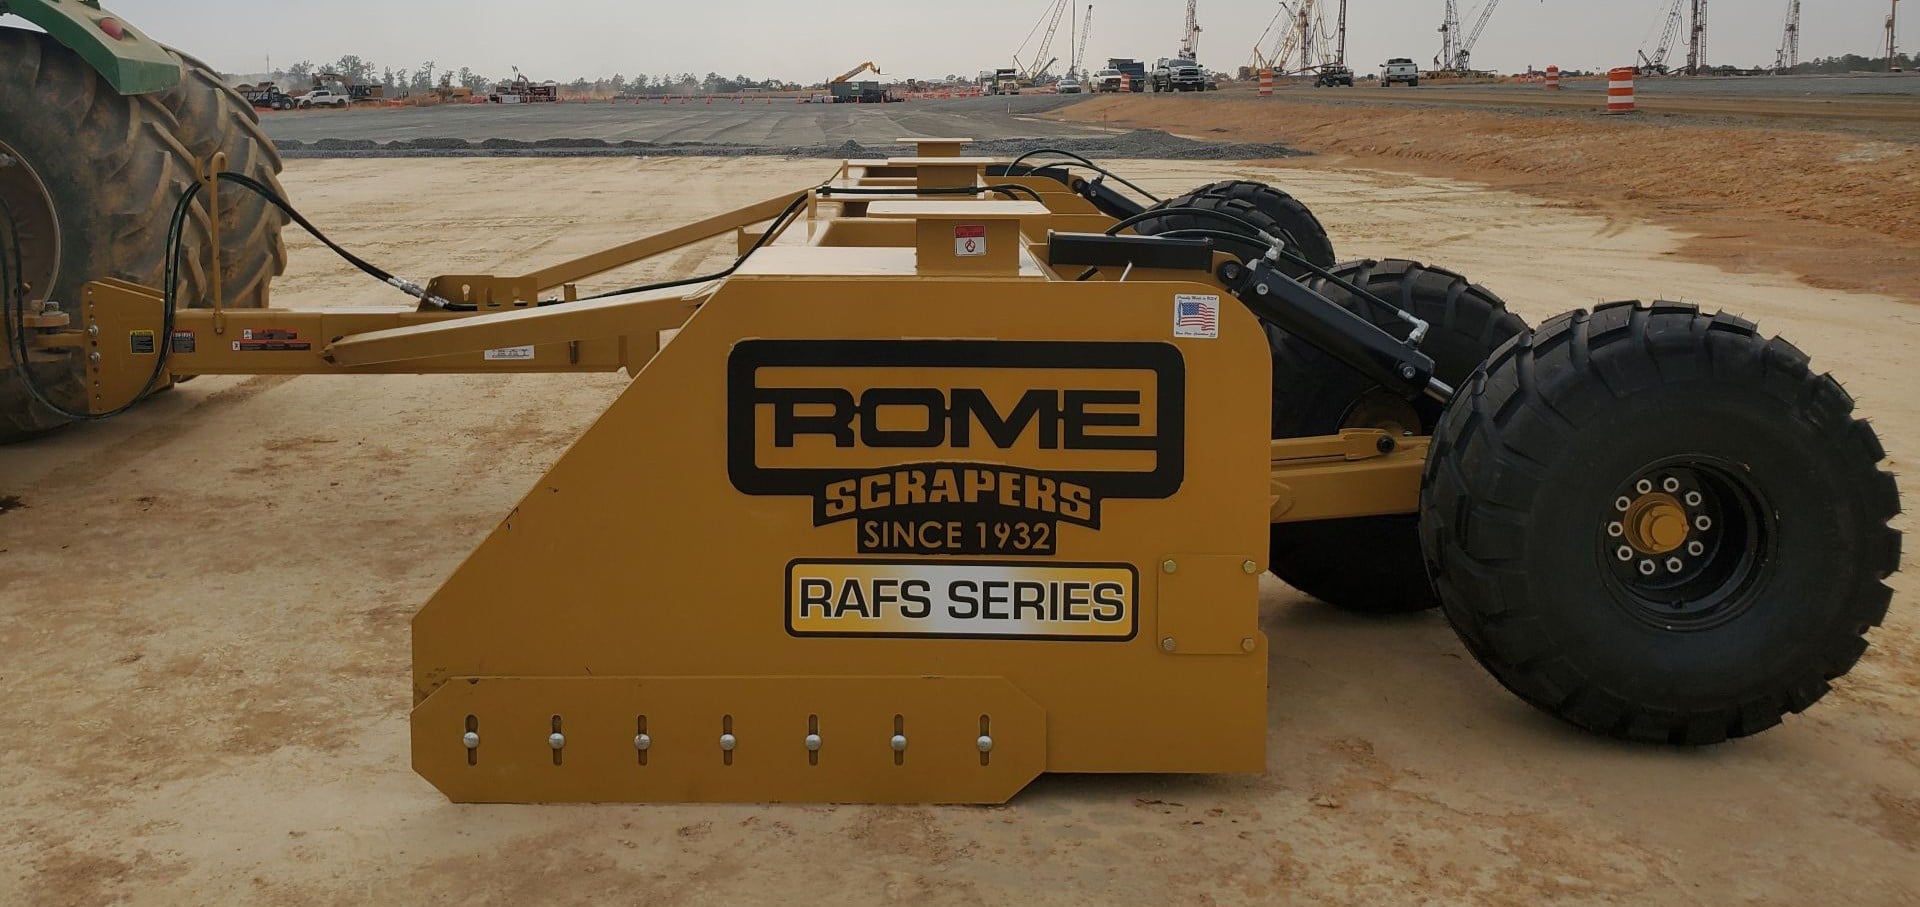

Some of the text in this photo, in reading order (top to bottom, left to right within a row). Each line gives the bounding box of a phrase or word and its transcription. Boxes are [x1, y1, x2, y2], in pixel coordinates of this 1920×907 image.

[771, 387, 1143, 450] ROME
[824, 468, 1092, 522] SCRAPERS
[863, 519, 1051, 551] SINCE 1932
[799, 578, 1126, 622] RAFS SERIES
